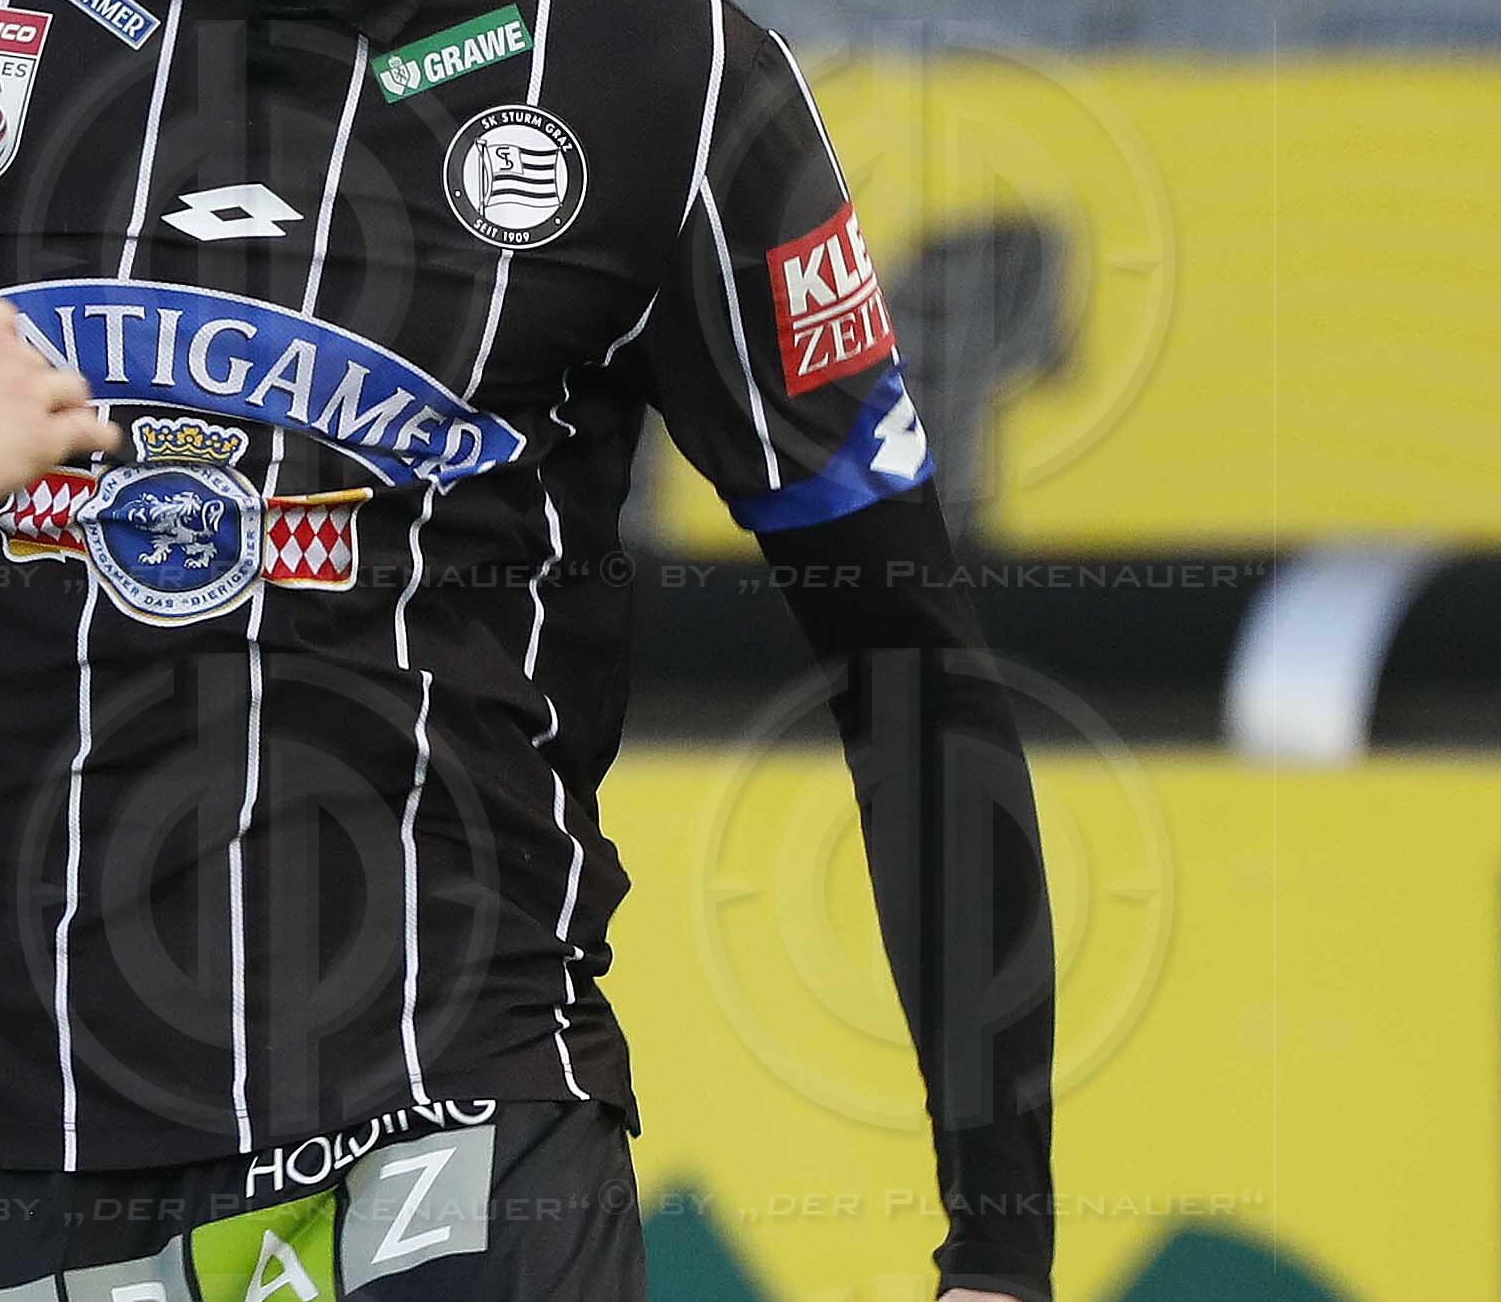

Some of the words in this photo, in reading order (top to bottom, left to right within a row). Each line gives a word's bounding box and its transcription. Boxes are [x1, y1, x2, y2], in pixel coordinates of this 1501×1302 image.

[423, 18, 526, 85] GRAWE
[481, 115, 498, 130] SK
[501, 111, 543, 128] STURM
[545, 122, 574, 153] GRAZ
[472, 218, 498, 239] SEIT
[502, 231, 530, 243] 1909
[15, 304, 484, 483] NTIGAMER
